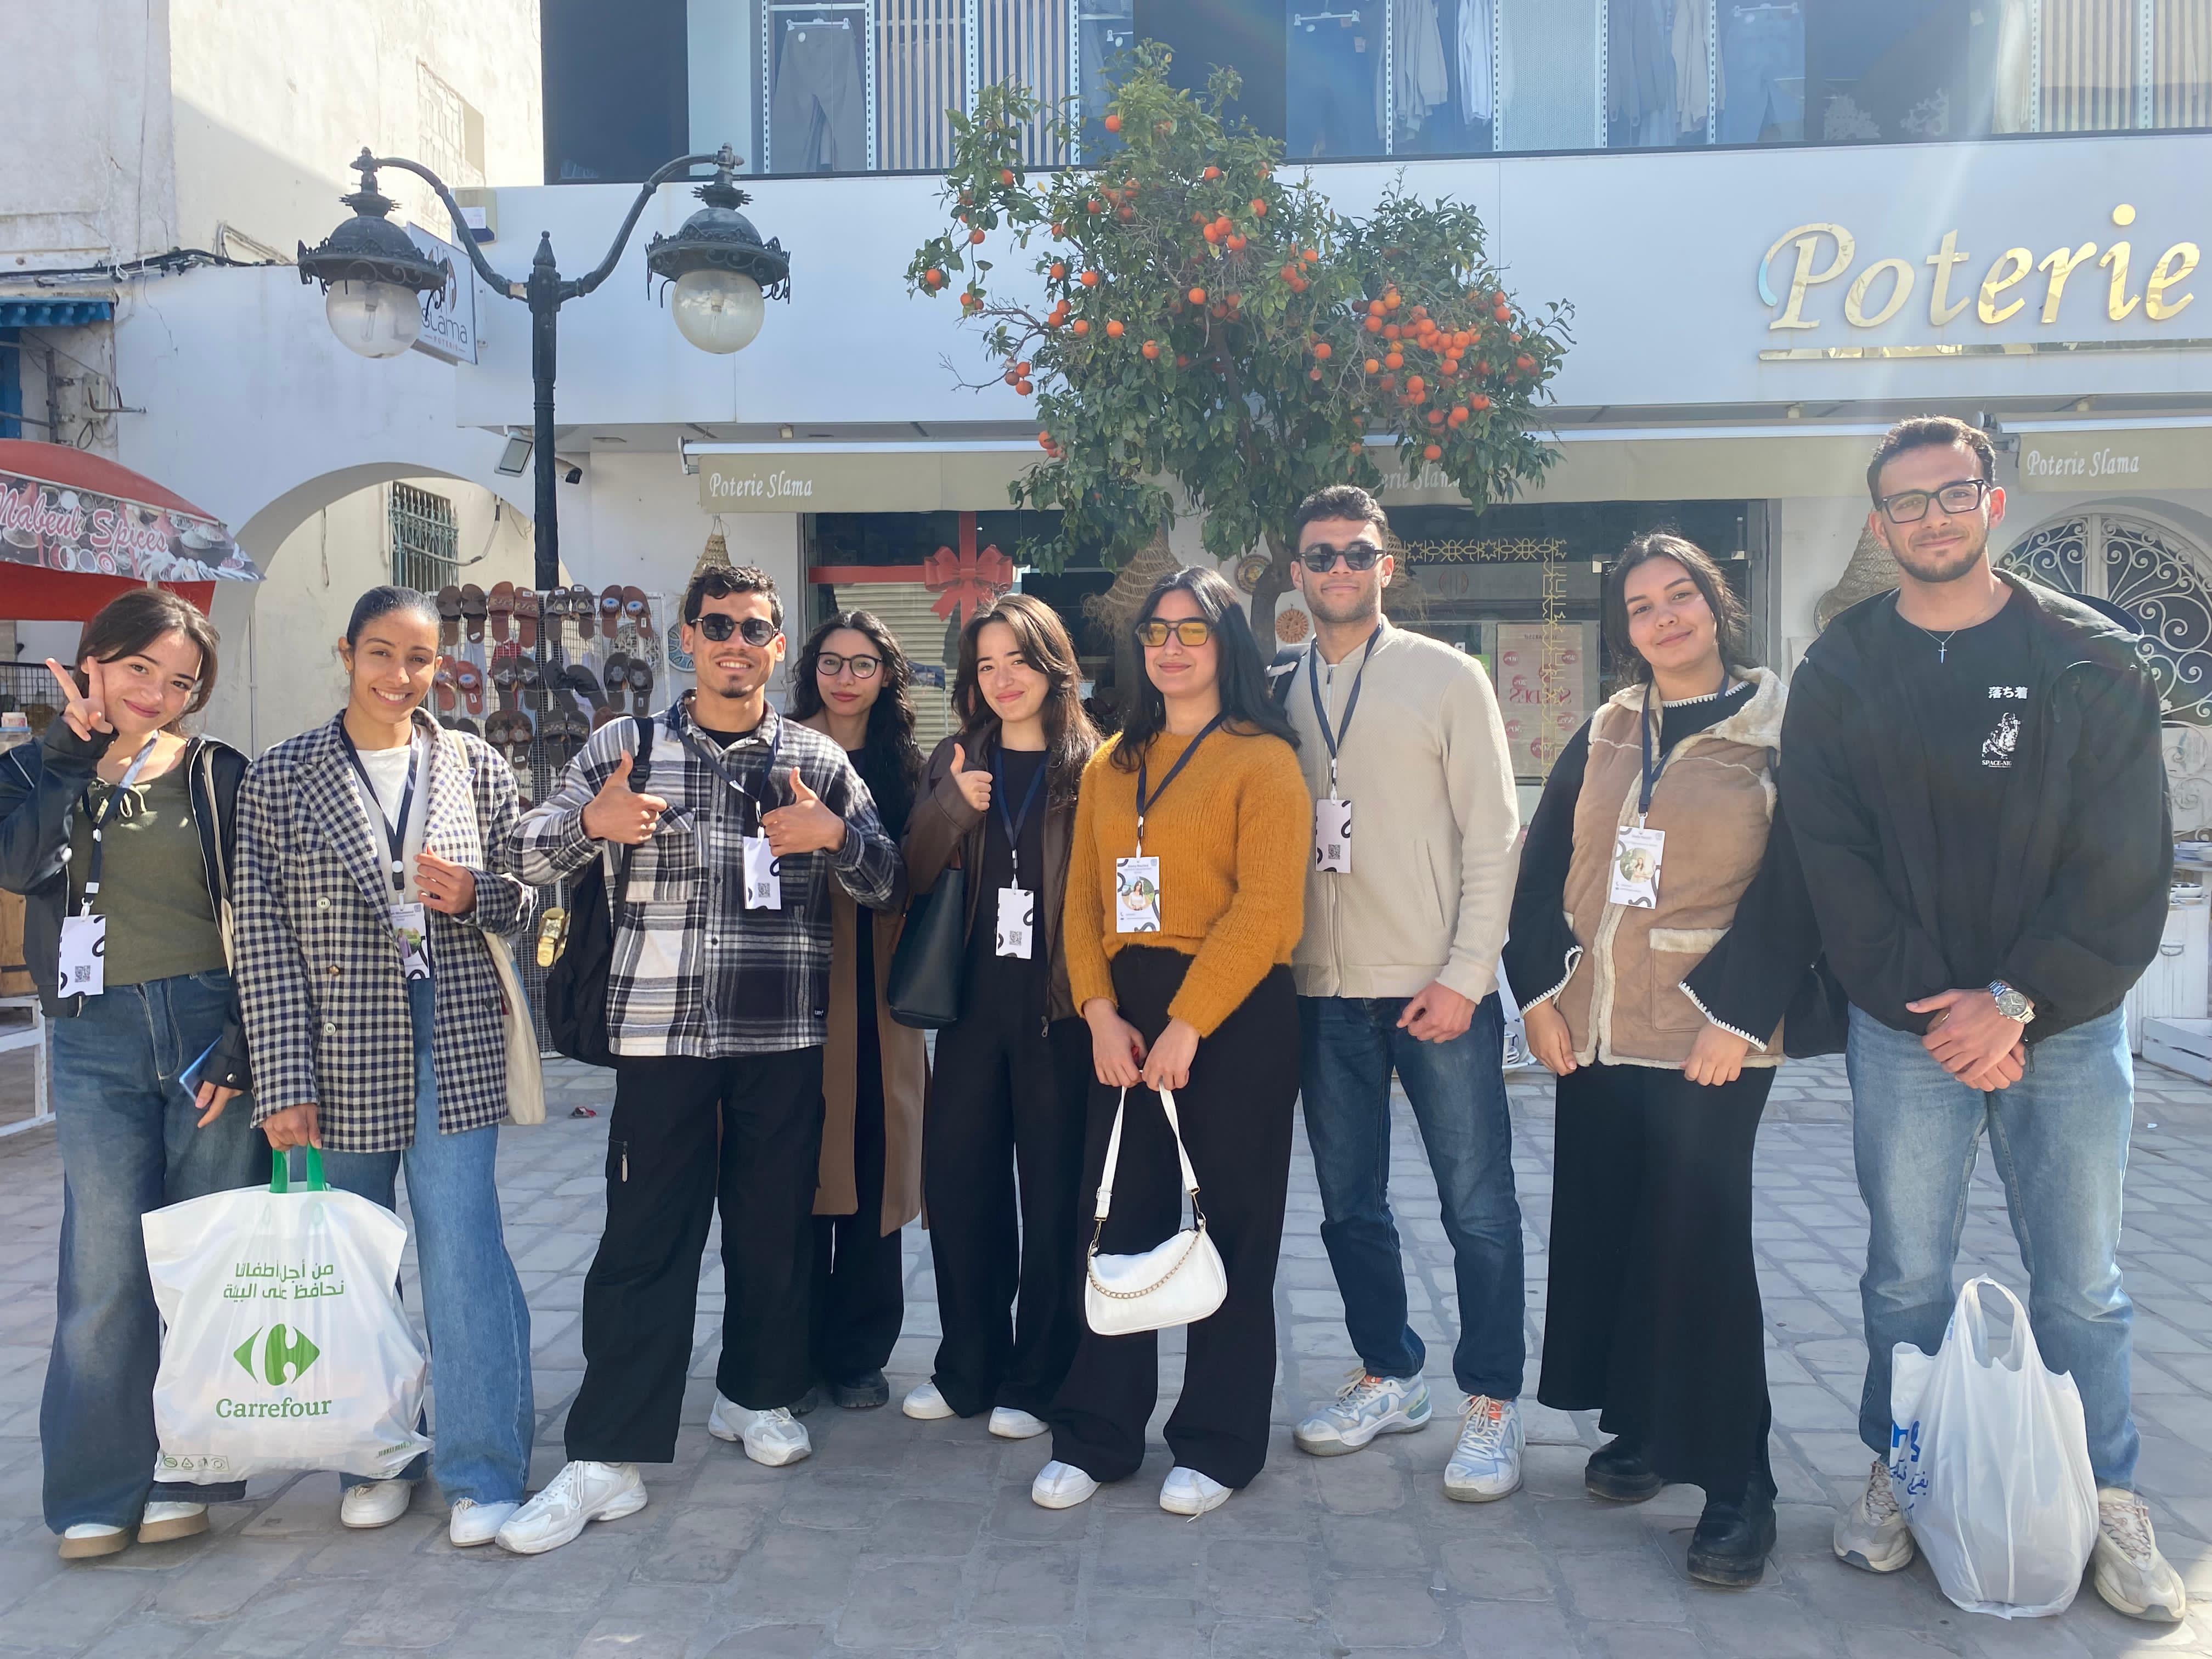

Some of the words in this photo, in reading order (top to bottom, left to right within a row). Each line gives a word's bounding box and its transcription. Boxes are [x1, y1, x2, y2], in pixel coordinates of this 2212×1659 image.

[1758, 204, 2200, 330] Poterie
[2028, 450, 2085, 476] Poterie
[2089, 448, 2139, 477] Slama
[710, 473, 763, 496] Poterie
[768, 470, 812, 498] Slama
[0, 483, 81, 540] Nabeul
[90, 509, 168, 556] Spices
[1988, 686, 2028, 699] 落ち着
[280, 1259, 305, 1283] أجل
[312, 1262, 334, 1279] من
[294, 1280, 345, 1299] نحافظ
[216, 1397, 332, 1418] Carrefour
